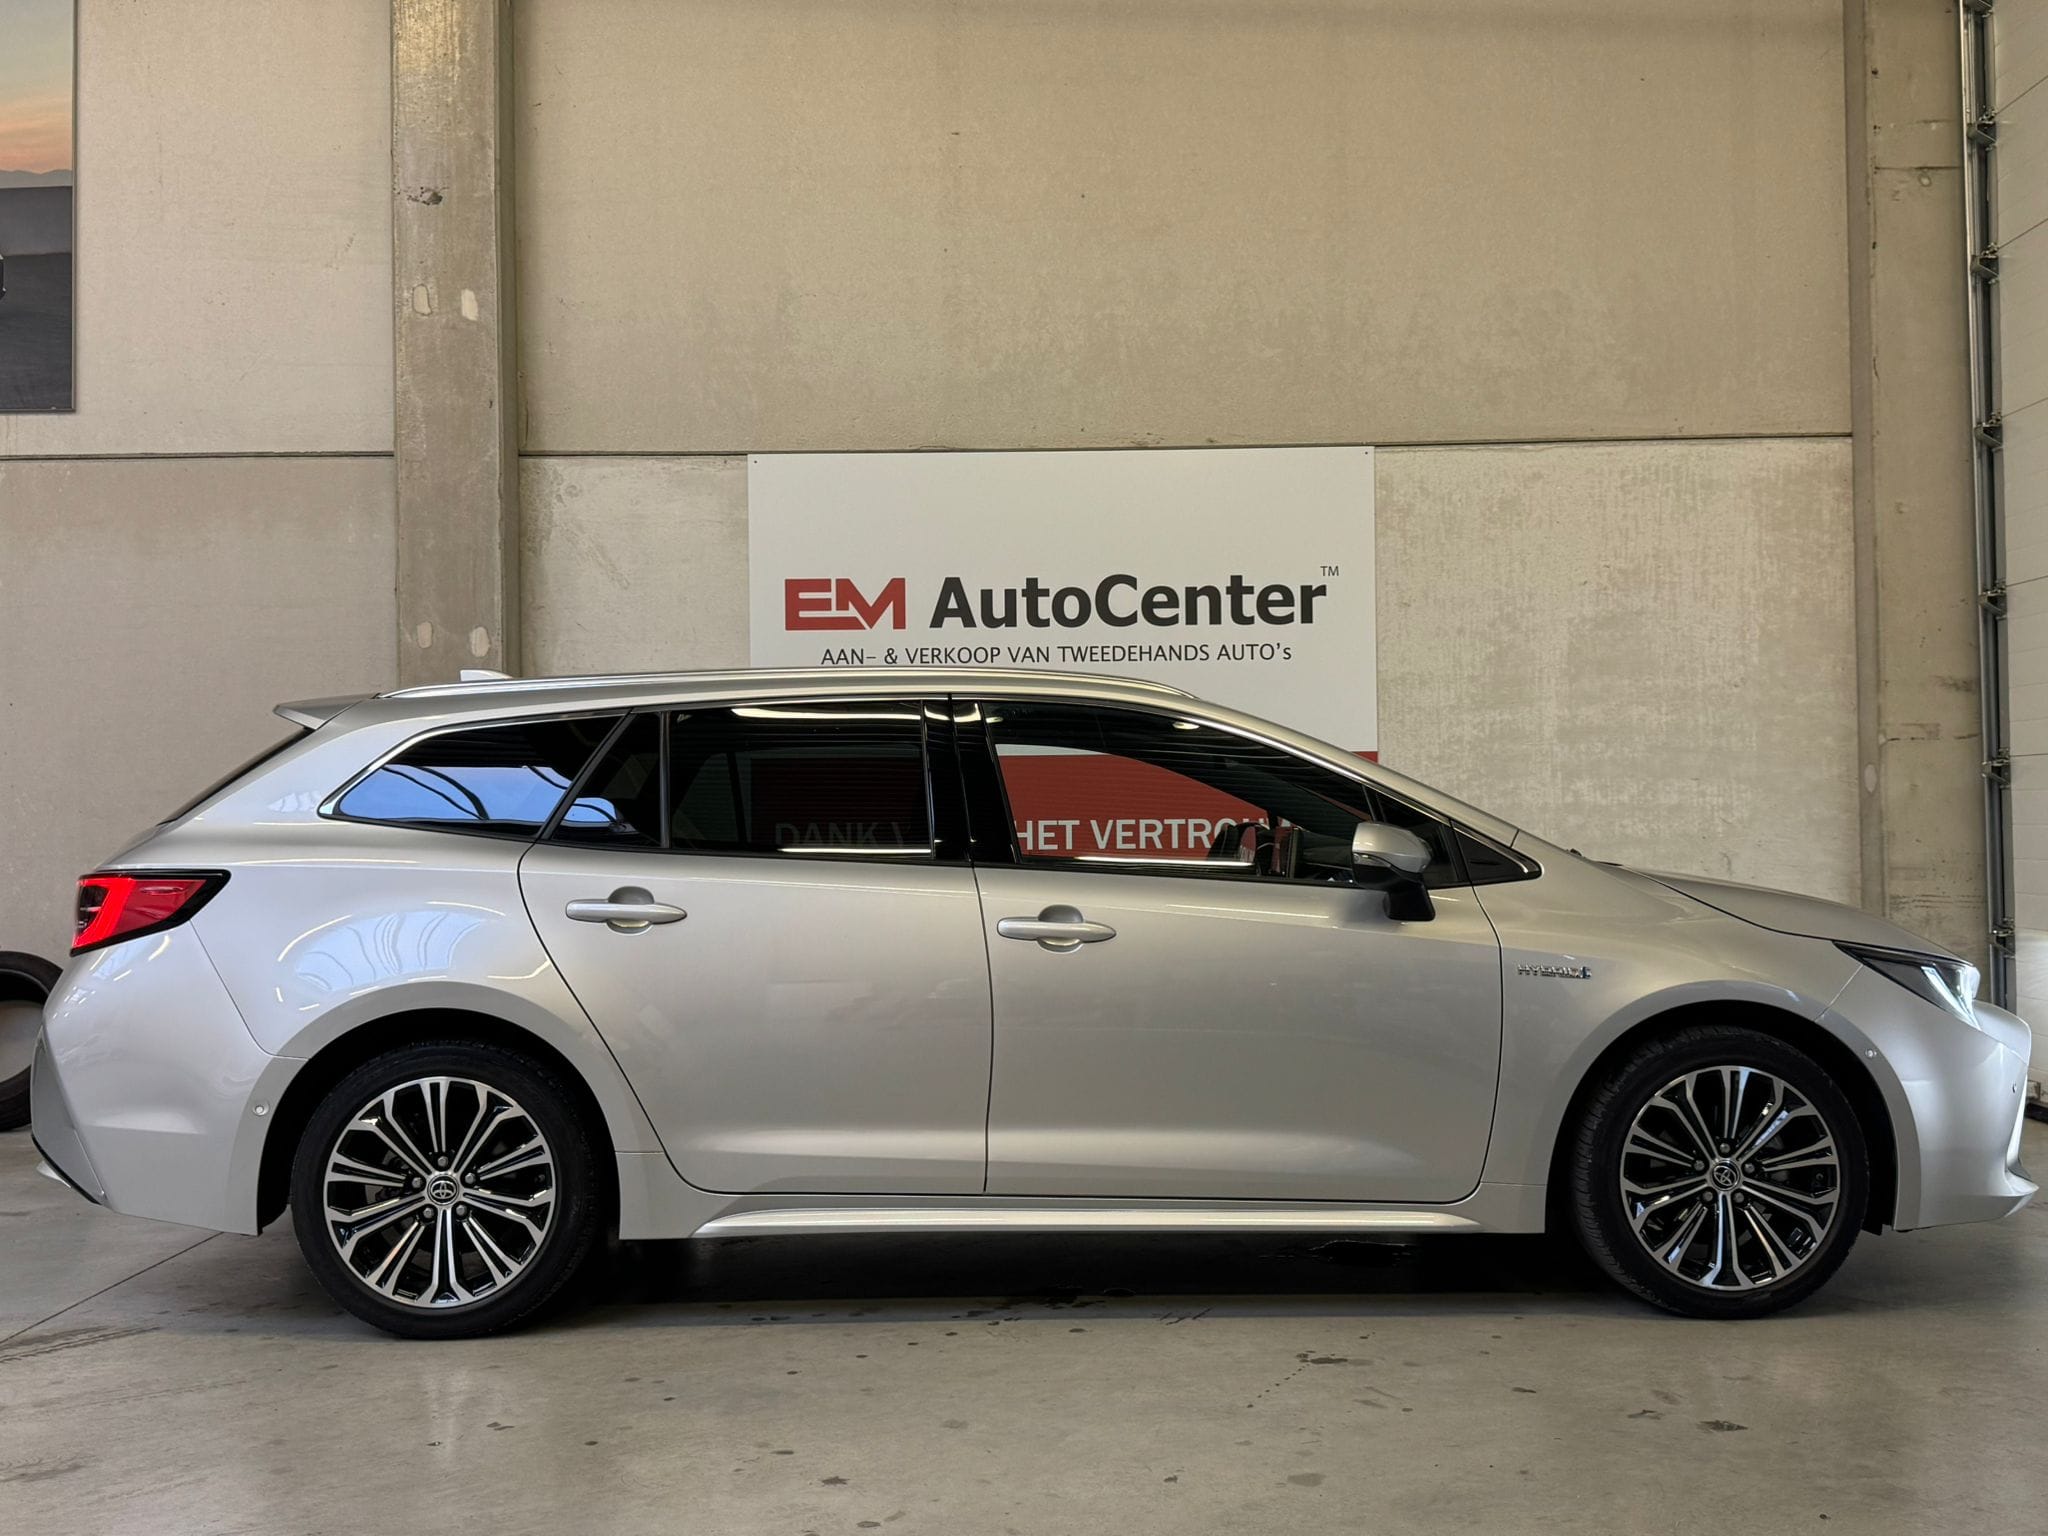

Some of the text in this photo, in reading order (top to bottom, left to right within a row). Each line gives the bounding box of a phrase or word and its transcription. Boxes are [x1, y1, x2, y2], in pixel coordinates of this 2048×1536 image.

[785, 578, 906, 631] EM
[929, 574, 1327, 628] AutoCenter
[821, 648, 876, 665] AAN-
[884, 647, 898, 664] &
[905, 646, 1001, 664] VERKOOP
[1007, 646, 1050, 663] VAN
[1057, 644, 1210, 662] TWEEDEHANDS
[775, 822, 878, 848] DANK
[1014, 819, 1080, 850] HET
